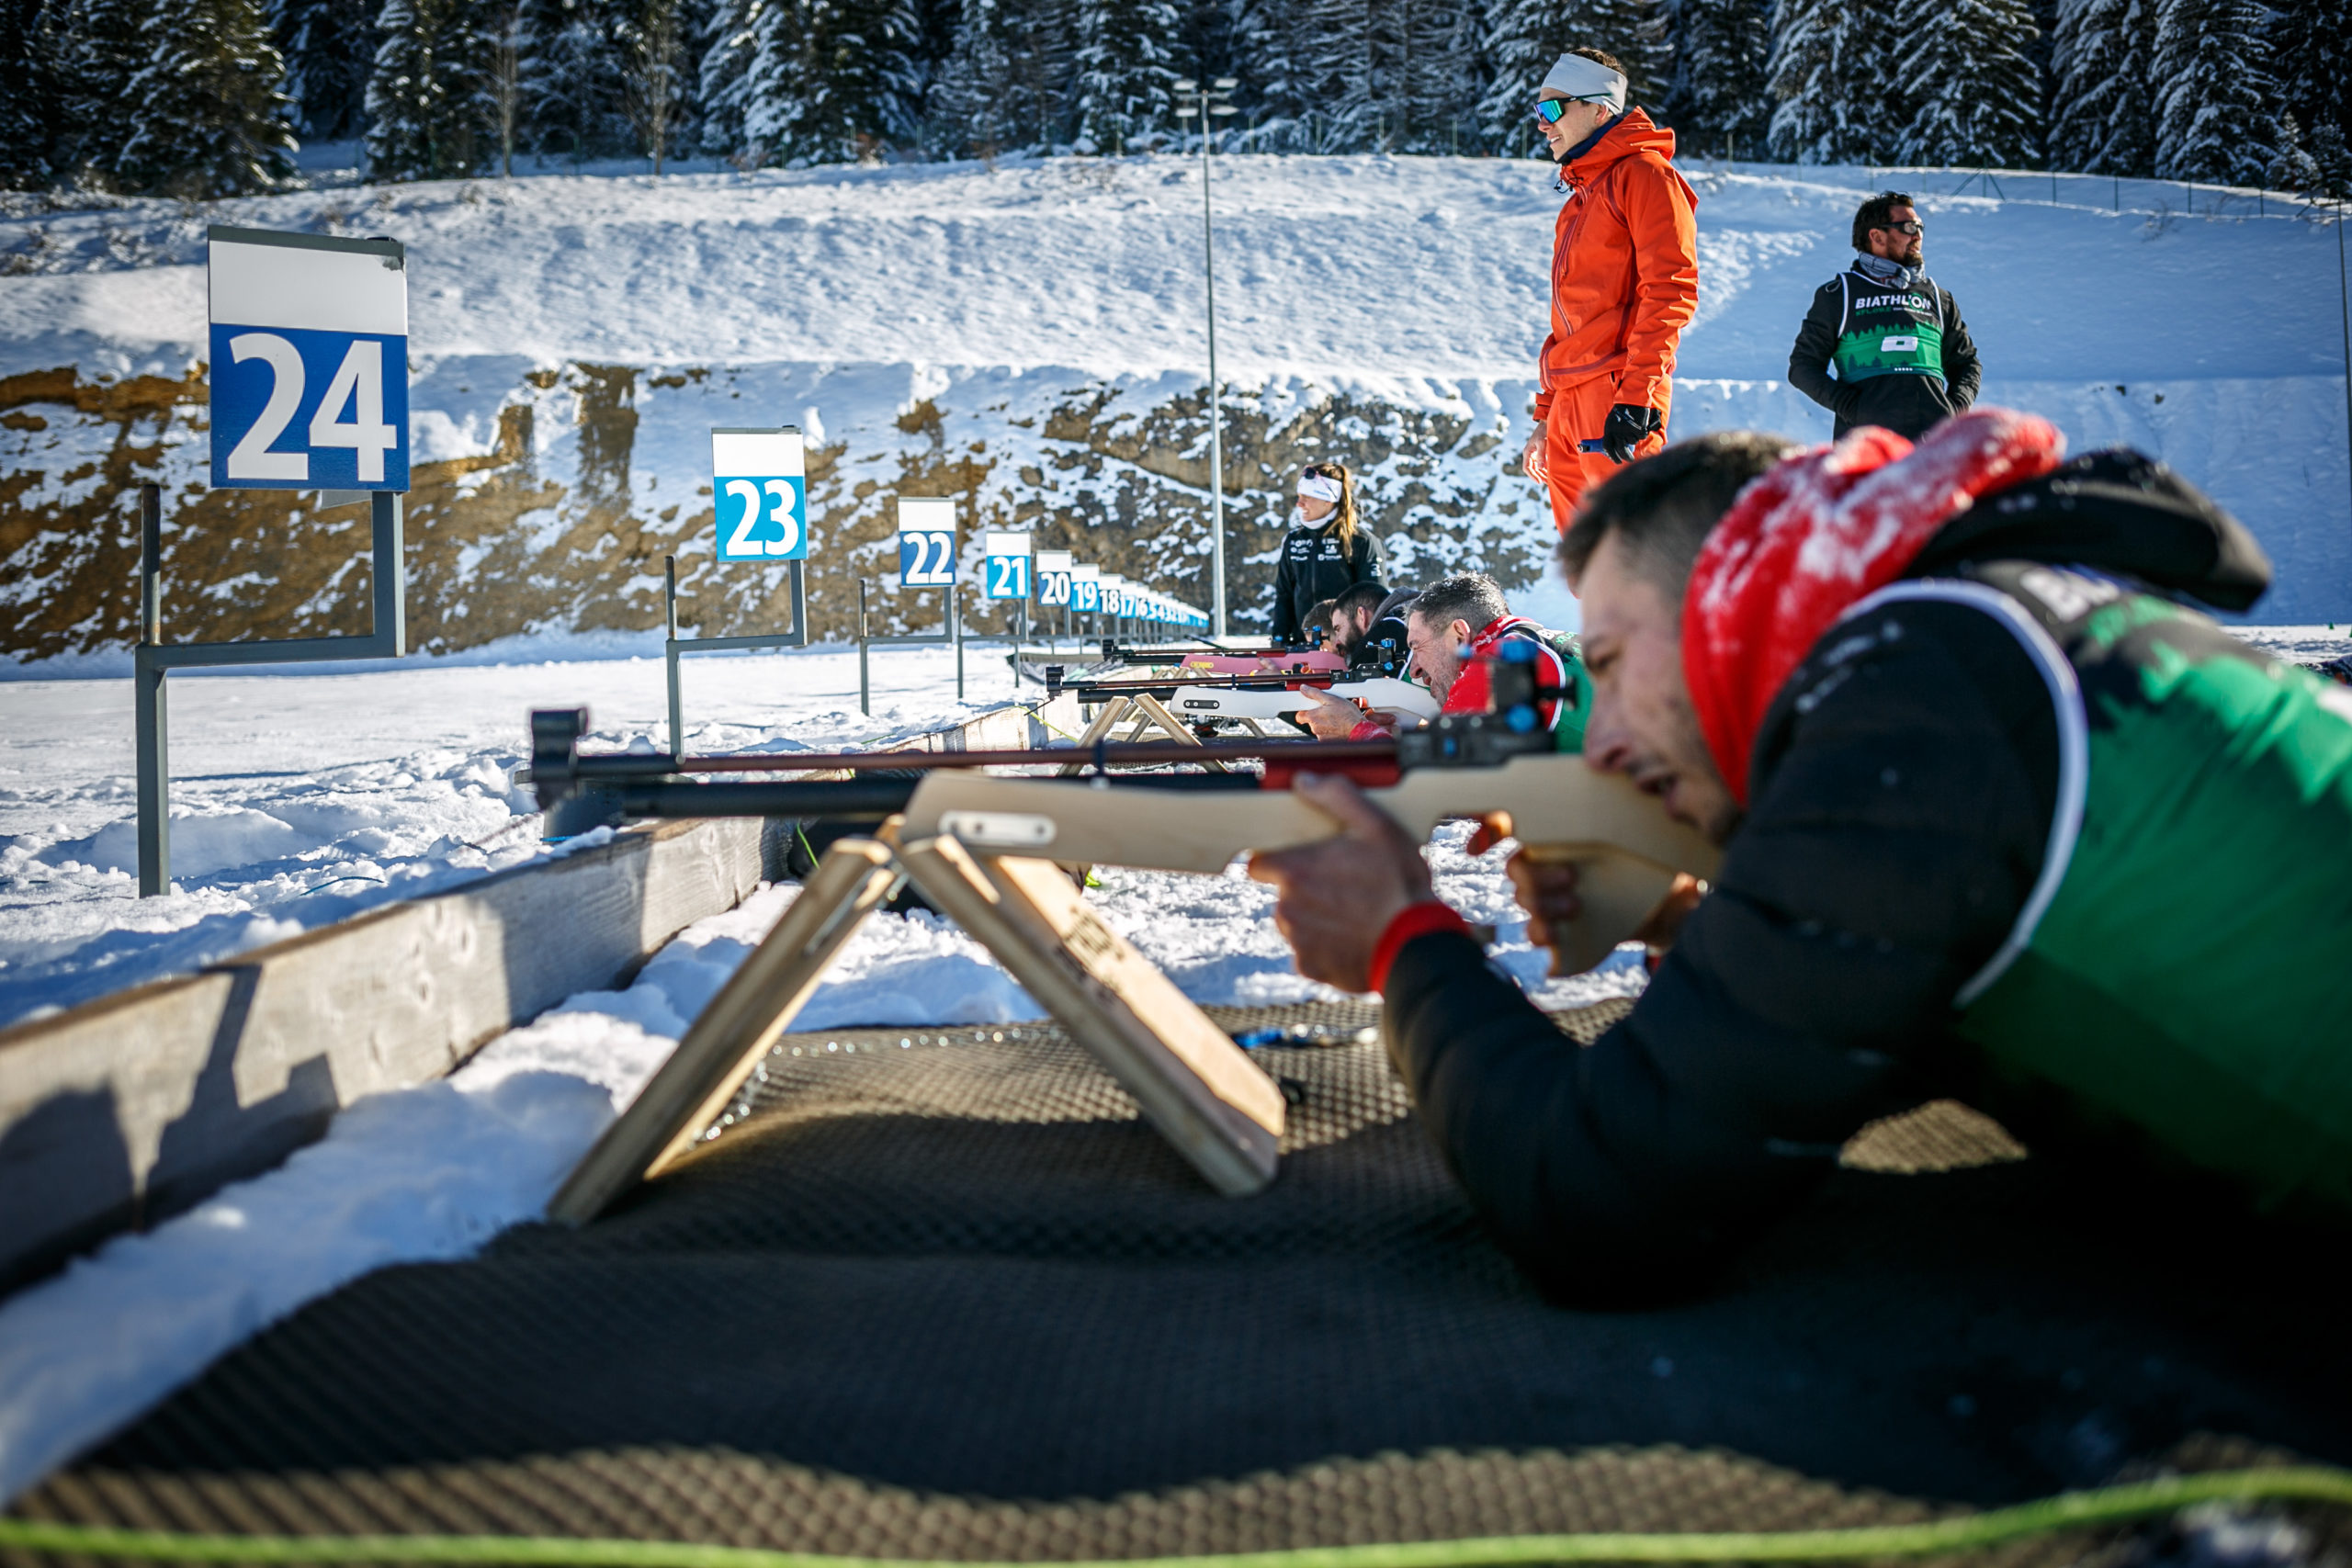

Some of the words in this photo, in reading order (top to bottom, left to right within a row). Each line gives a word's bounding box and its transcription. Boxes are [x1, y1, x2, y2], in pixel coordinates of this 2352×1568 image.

[227, 332, 397, 482] 24
[726, 478, 799, 557] 23
[903, 531, 953, 584] 22
[992, 557, 1026, 596] 21
[1040, 572, 1070, 604] 20
[1074, 582, 1098, 609] 19
[1099, 590, 1120, 614] 18
[1120, 595, 1136, 616] 17
